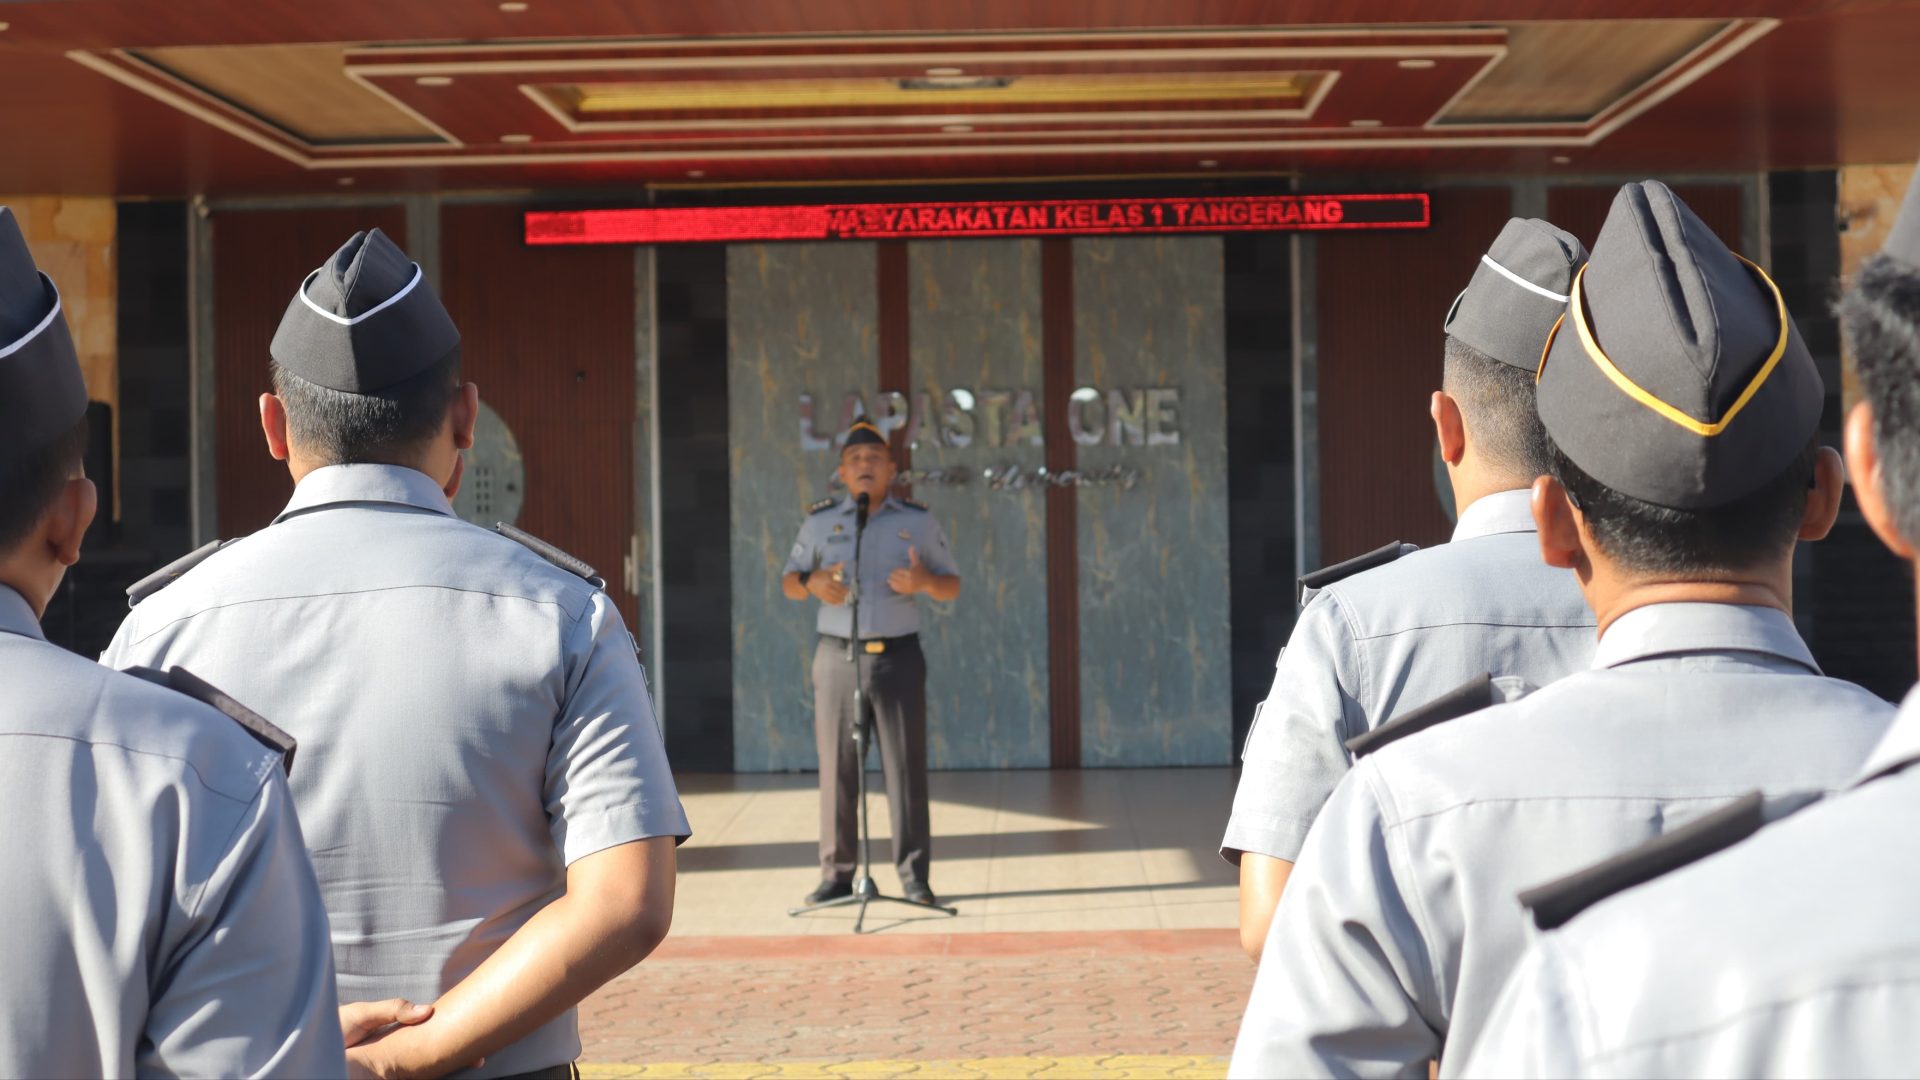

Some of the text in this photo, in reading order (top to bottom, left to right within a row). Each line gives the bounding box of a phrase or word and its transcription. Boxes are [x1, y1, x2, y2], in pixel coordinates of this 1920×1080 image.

[1055, 203, 1144, 228] KELAS
[1151, 203, 1164, 225] 1
[1173, 199, 1343, 224] TANGERANG
[1068, 386, 1180, 447] ONE
